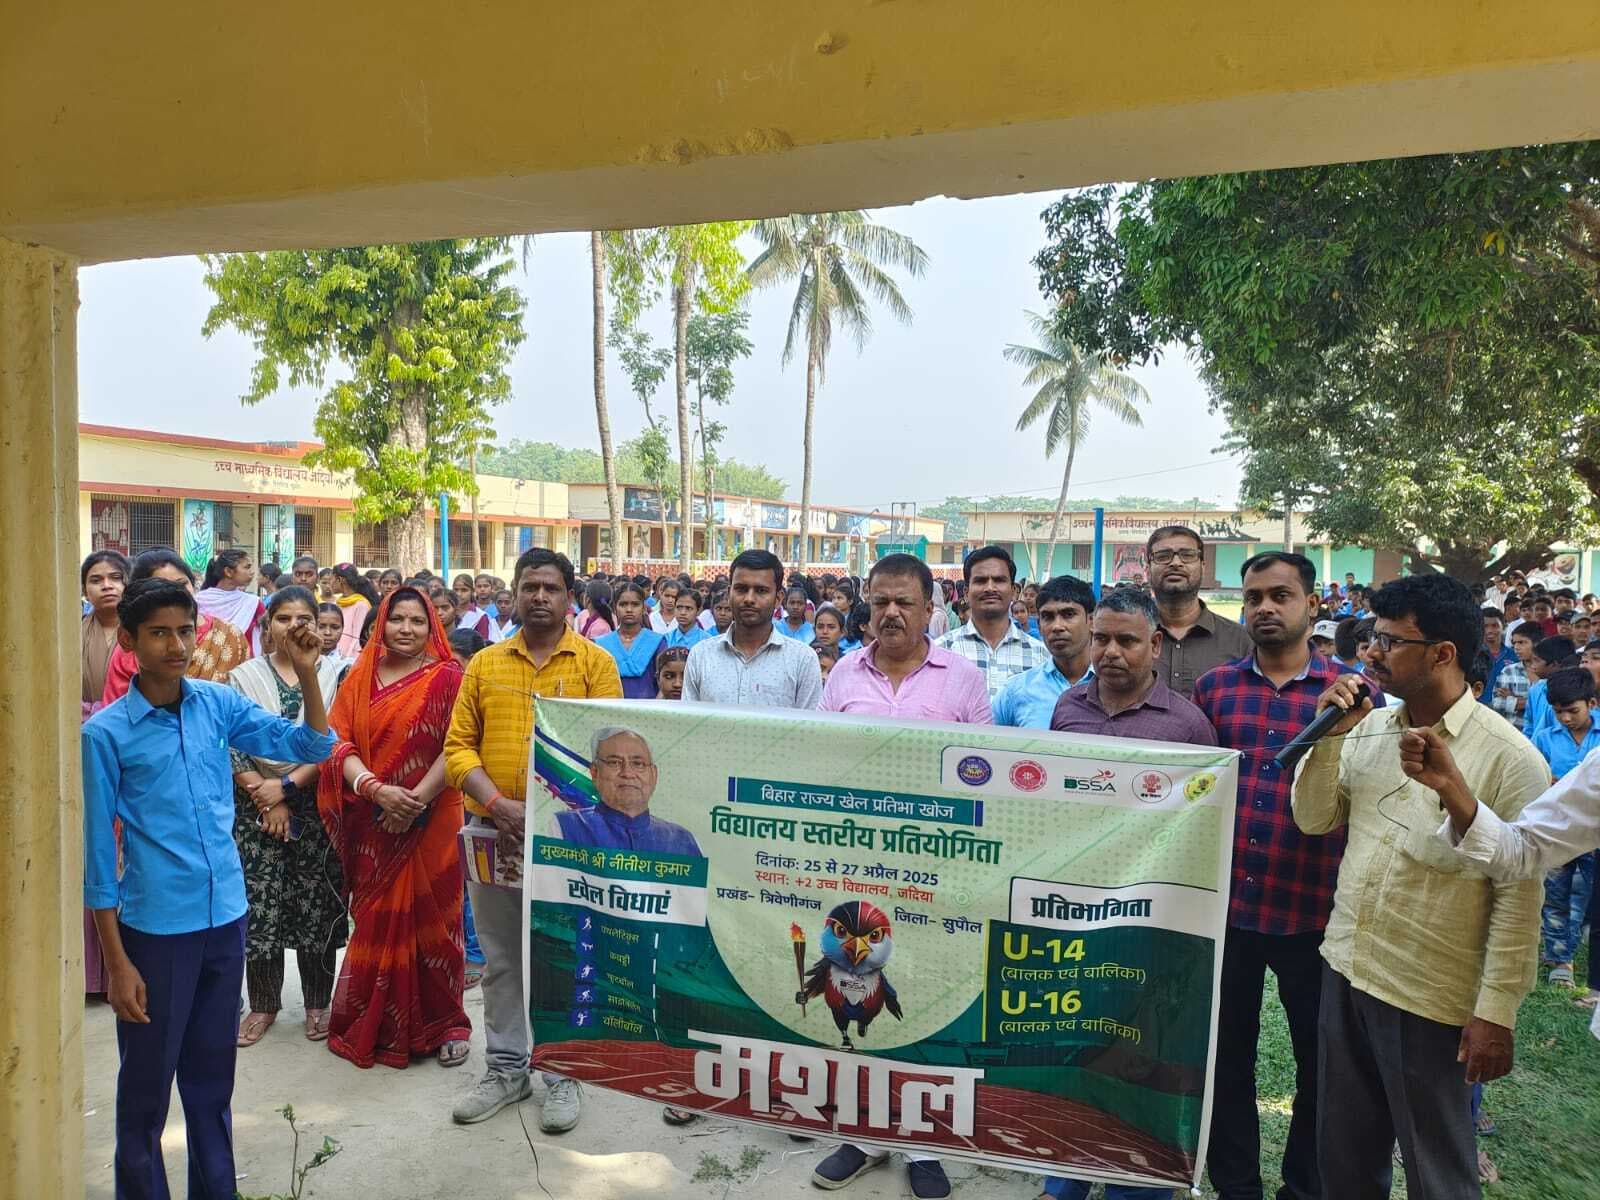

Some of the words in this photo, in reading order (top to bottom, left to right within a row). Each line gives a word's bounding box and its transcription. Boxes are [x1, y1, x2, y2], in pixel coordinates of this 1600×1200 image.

[761, 784, 797, 803] बिहार
[799, 791, 835, 807] राज्य
[838, 791, 868, 811] खेल
[872, 796, 915, 816] प्रतिभा
[918, 800, 955, 819] खोज
[1063, 778, 1117, 793] BSSA
[709, 805, 798, 841] विद्यालय
[801, 818, 876, 850] स्तरीय
[880, 824, 1003, 865] प्रतियोगिता
[540, 844, 589, 866] मुख्यमंत्री
[591, 852, 606, 869] श्री
[609, 853, 650, 873] नीतीश
[654, 861, 693, 877] कुमार
[754, 851, 800, 870] दिनांक:
[803, 859, 822, 872] 25
[825, 858, 838, 874] से
[841, 863, 859, 876] 27
[902, 870, 939, 886] 2025
[567, 876, 605, 905] खेल
[608, 884, 672, 915] विधाएं
[754, 870, 790, 886] स्थान:
[795, 877, 812, 889] +2
[815, 878, 838, 891] उच्च
[842, 878, 893, 899] विद्यालय,
[896, 885, 935, 903] जदिया
[760, 889, 822, 911] त्रिवेणीगंज
[894, 906, 937, 925] जिला-
[941, 916, 983, 934] सुपौल
[1030, 893, 1153, 922] प्रतिभागिता
[1003, 931, 1086, 963] U-14
[1000, 966, 1054, 983] (बालक
[1058, 965, 1080, 980] एवं
[1083, 962, 1146, 984] बालिका)
[1001, 989, 1083, 1016] U-16
[999, 1019, 1050, 1035] (बालक
[1056, 1017, 1076, 1031] एवं
[1079, 1017, 1142, 1045] बालिका)
[687, 1028, 985, 1137] मशाल
